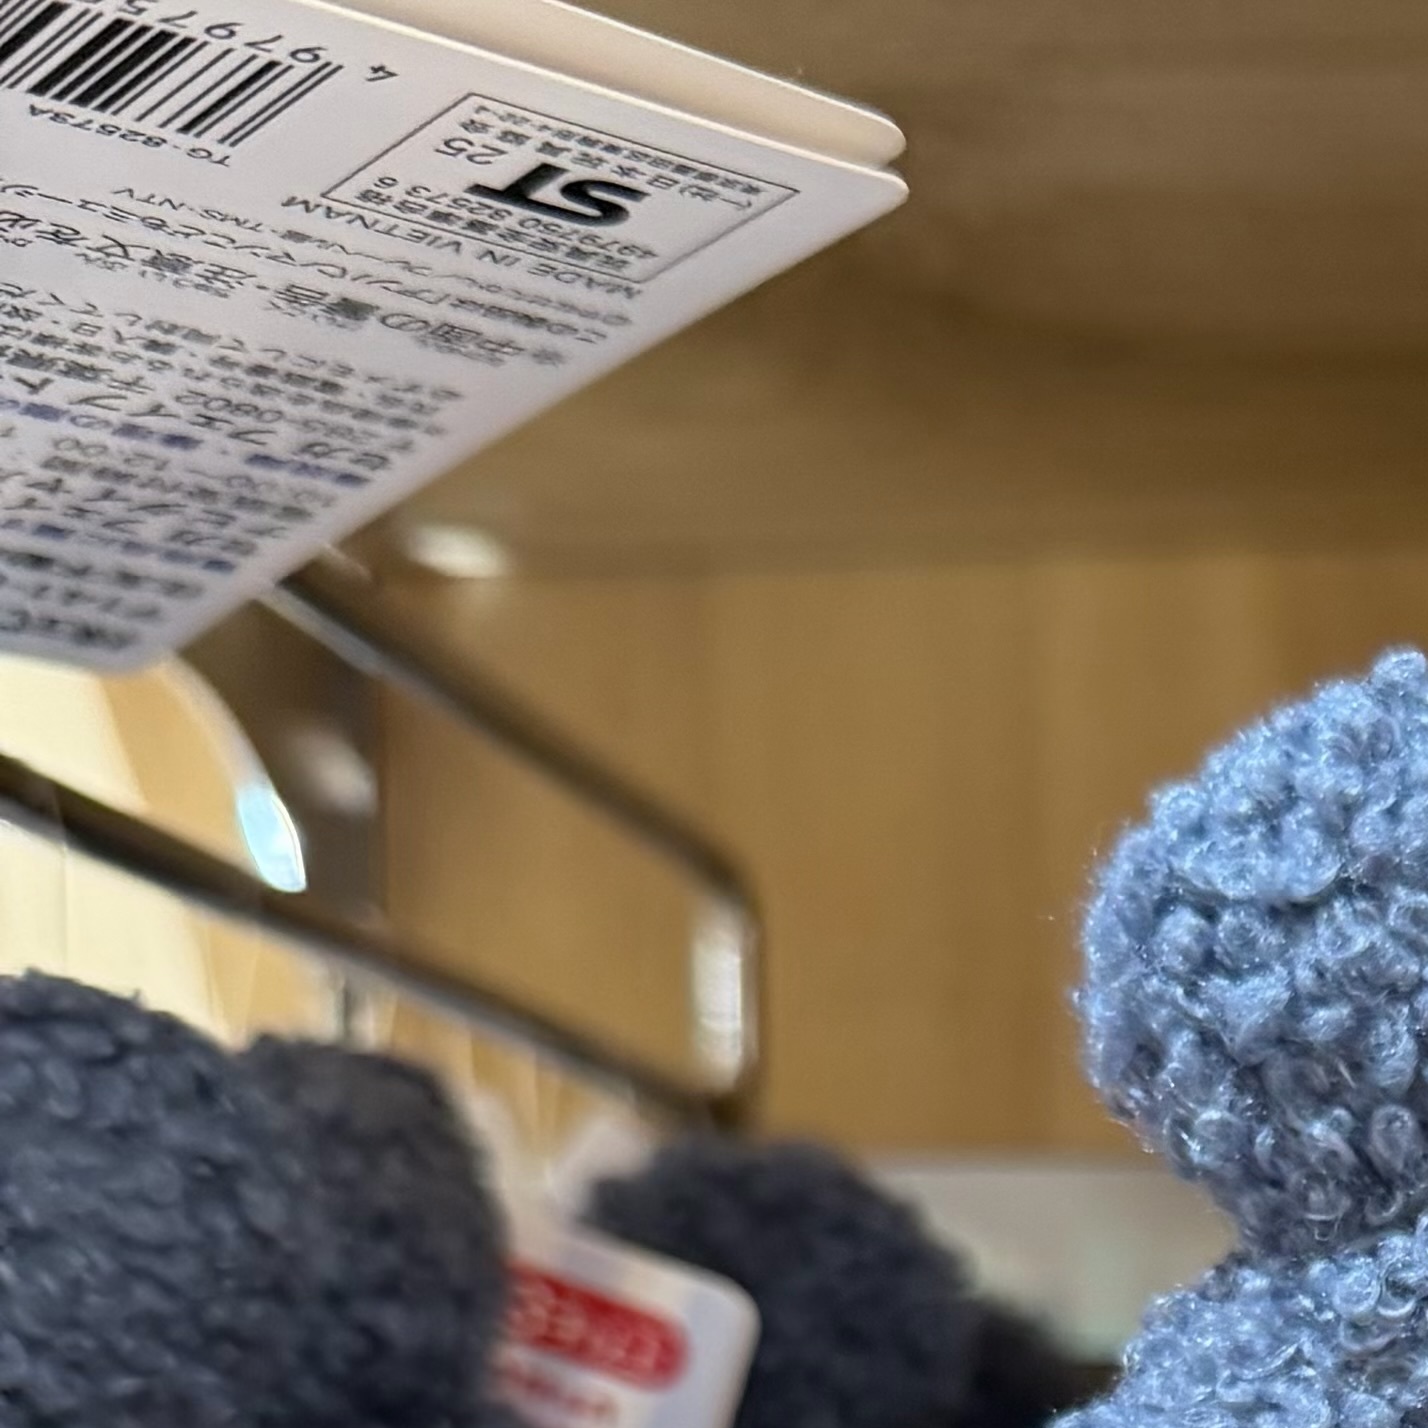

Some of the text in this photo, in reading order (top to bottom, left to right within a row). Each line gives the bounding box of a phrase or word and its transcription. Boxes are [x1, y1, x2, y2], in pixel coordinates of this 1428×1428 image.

[113, 0, 327, 64] 97975
[433, 135, 509, 166] 25
[463, 165, 649, 227] ST
[280, 195, 642, 300] MADE IN VIETNAM
